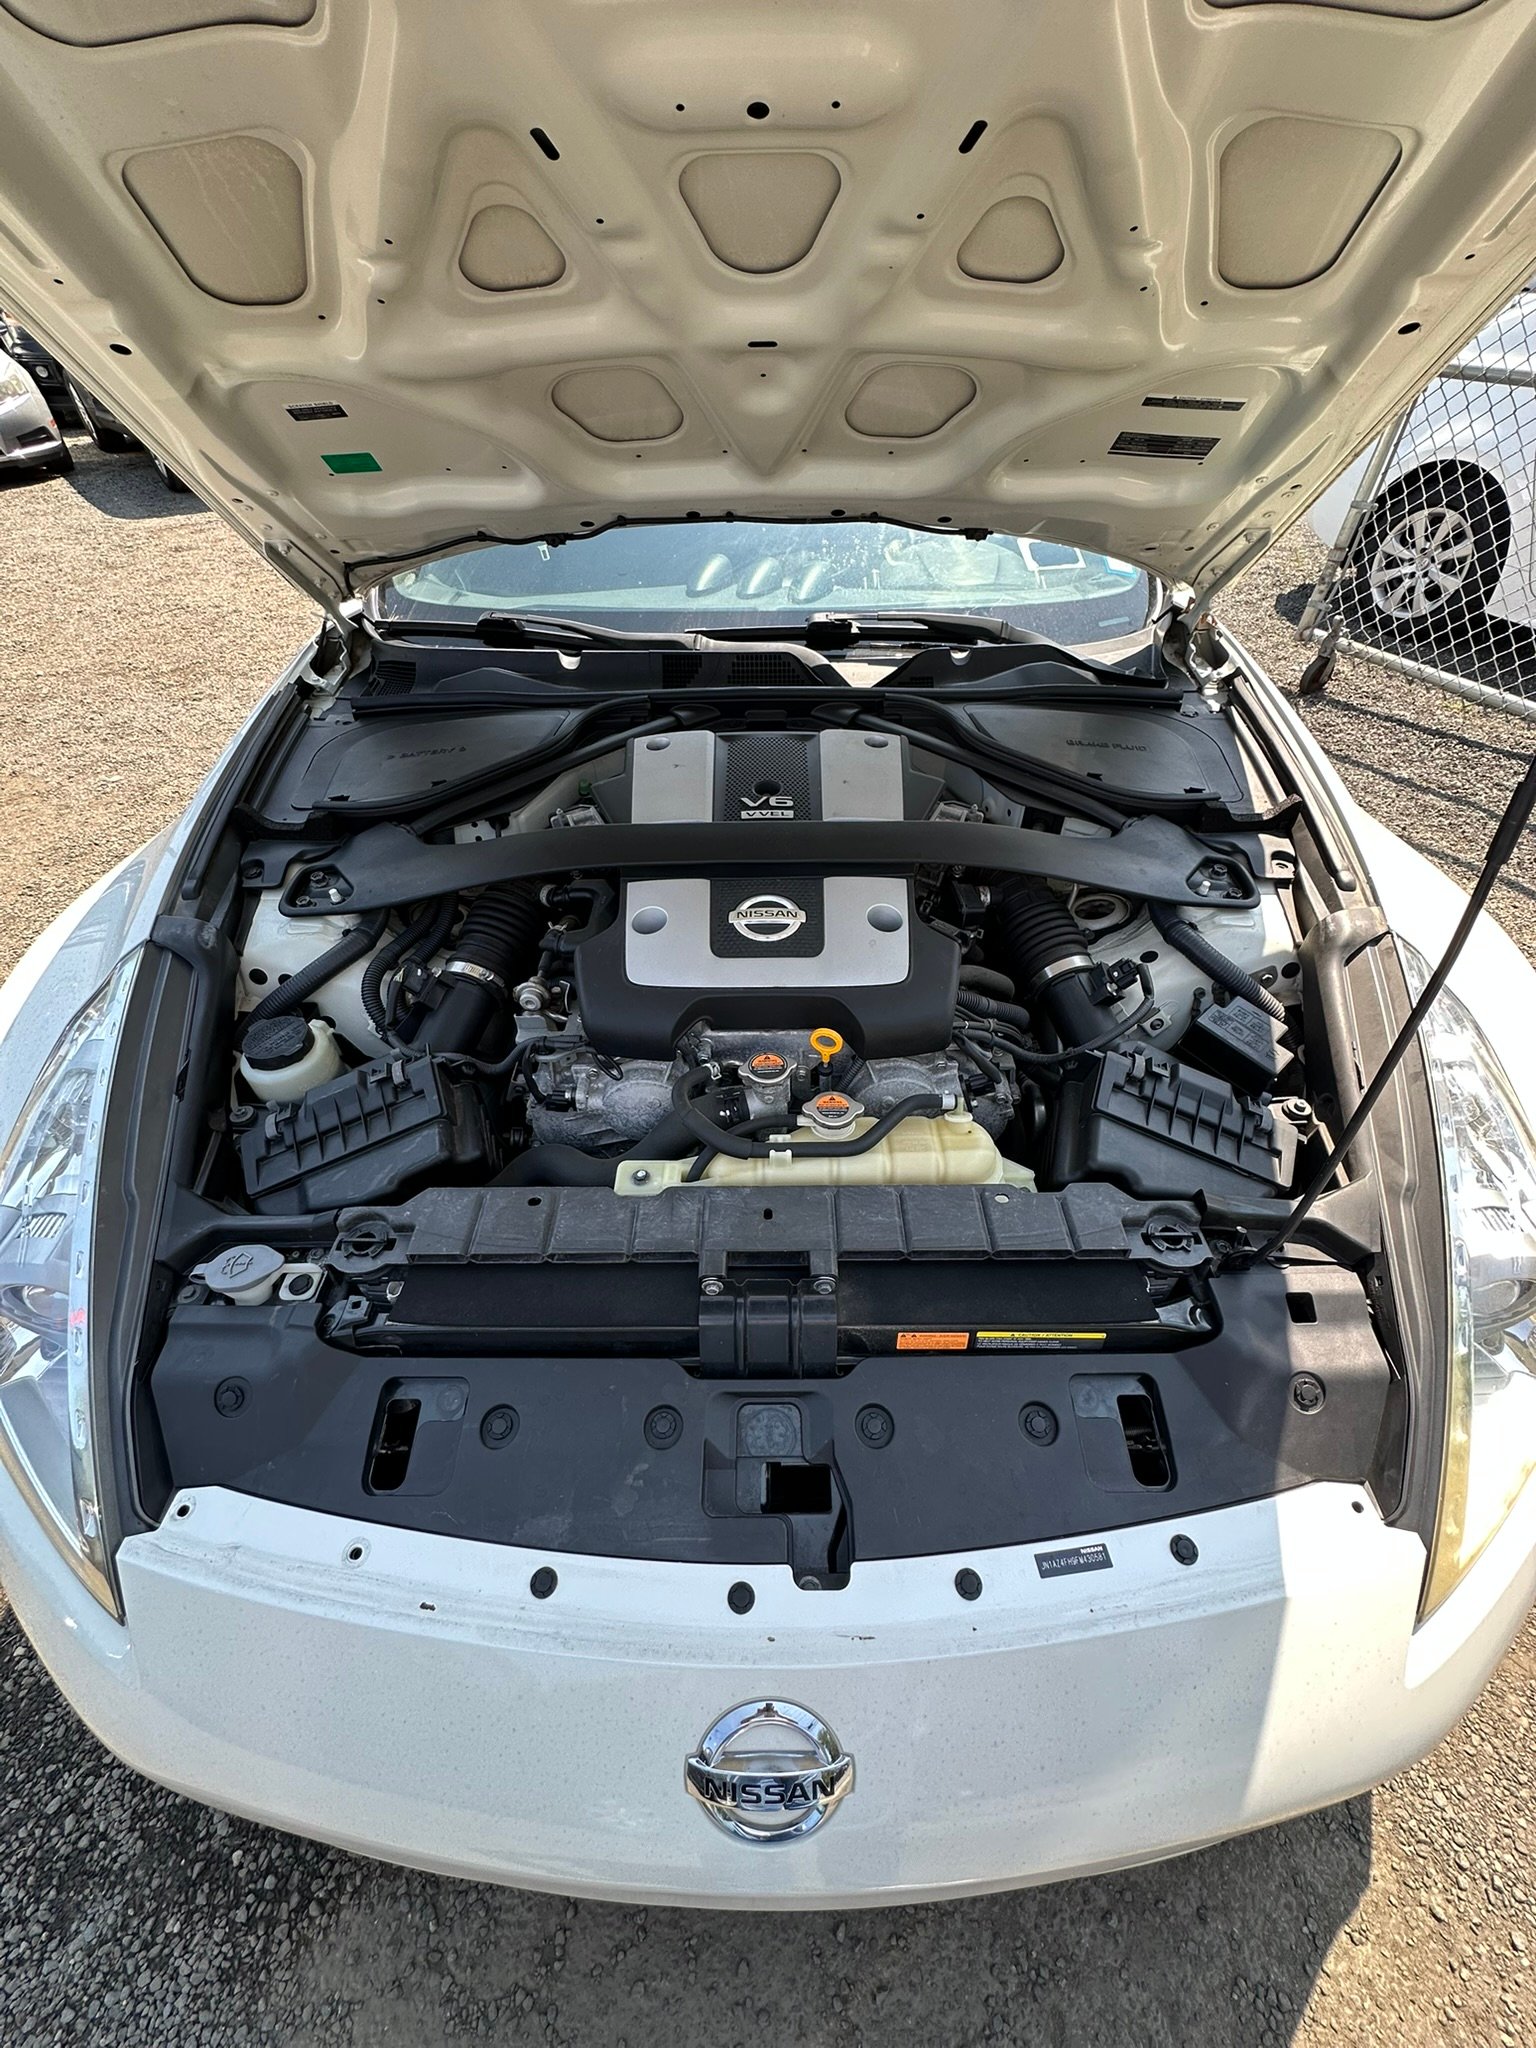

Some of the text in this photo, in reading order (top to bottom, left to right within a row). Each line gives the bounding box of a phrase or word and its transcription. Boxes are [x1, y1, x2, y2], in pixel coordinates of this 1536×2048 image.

[740, 796, 794, 807] V6
[736, 910, 799, 919] NISSAN
[1080, 1545, 1104, 1554] NISSAN
[703, 1776, 836, 1805] NISSAN
